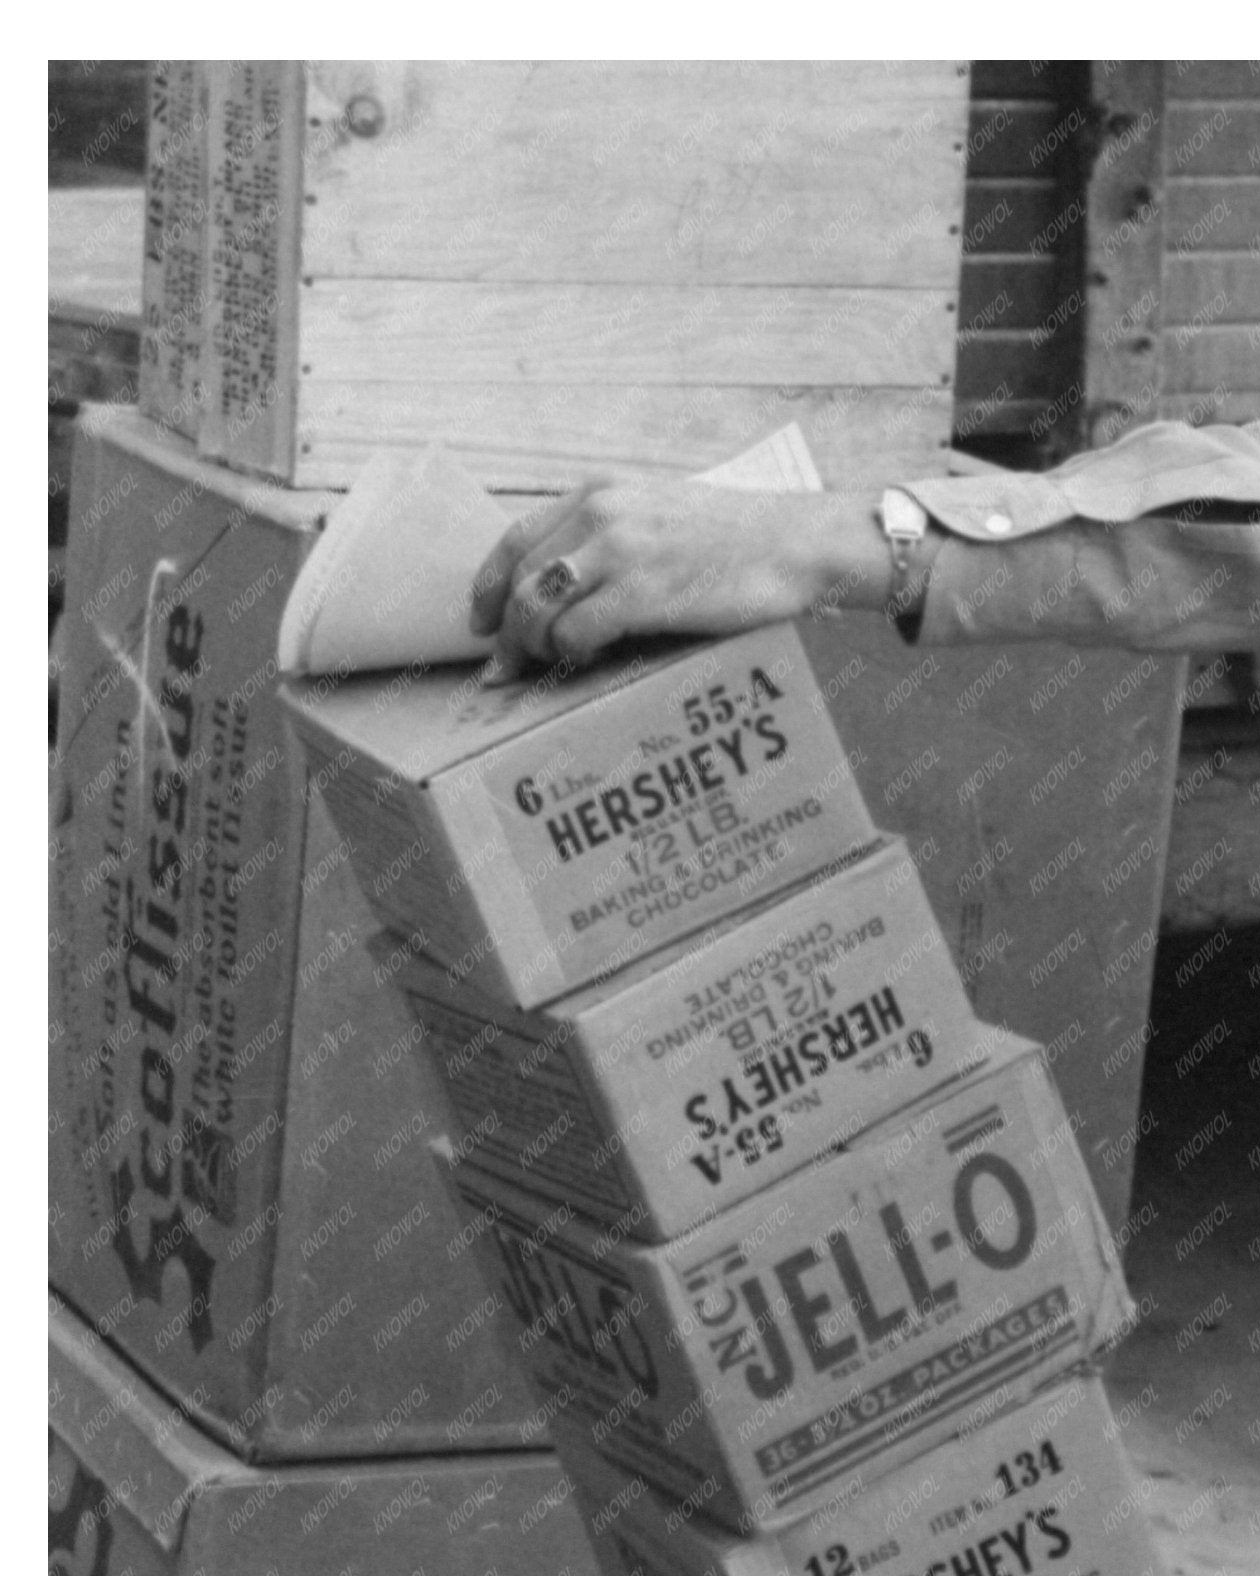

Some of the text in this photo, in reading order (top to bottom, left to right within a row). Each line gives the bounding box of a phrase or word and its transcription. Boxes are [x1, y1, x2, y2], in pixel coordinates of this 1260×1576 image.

[514, 775, 543, 817] 6
[638, 734, 682, 759] No.
[682, 666, 785, 736] 55-A
[545, 713, 789, 864] HERSHEY'S
[686, 801, 750, 848] LB.
[195, 799, 221, 1028] absorbent
[209, 698, 230, 785] soft
[569, 872, 667, 933] BAKING
[698, 797, 823, 870] DRINKING
[102, 874, 121, 951] old
[796, 915, 886, 977] BAKING
[104, 967, 118, 1028] as
[683, 921, 834, 1016] CHOCOLATE
[215, 998, 237, 1125] white
[646, 982, 767, 1061] DRINKING
[684, 984, 905, 1141] HERSHEY'S
[718, 1004, 778, 1051] LB.
[906, 1028, 934, 1069] 6
[782, 1088, 824, 1114] No.
[690, 1114, 784, 1186] 55-A
[739, 1152, 1037, 1401] JELL-O
[912, 1295, 1065, 1388] PACKAGES
[858, 1539, 901, 1572] BAGS
[994, 1439, 1064, 1498] 134
